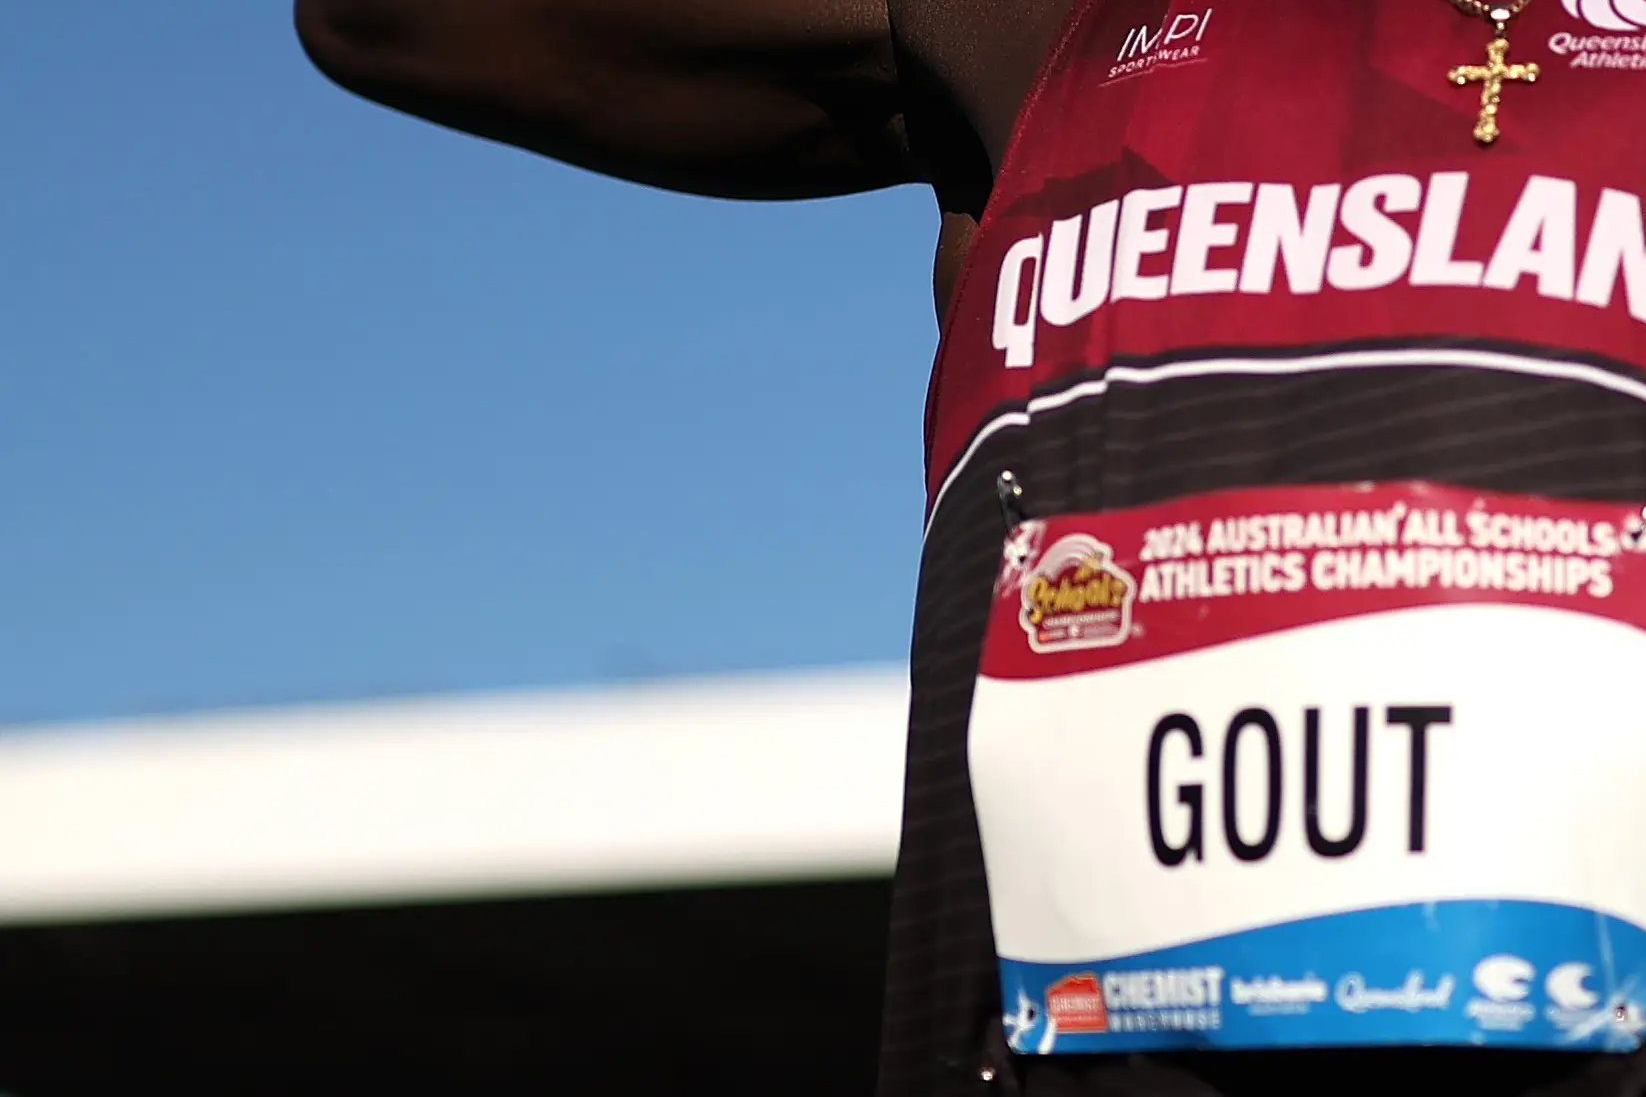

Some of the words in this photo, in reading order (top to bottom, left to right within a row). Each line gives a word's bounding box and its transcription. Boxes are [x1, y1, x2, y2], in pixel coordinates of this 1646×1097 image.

[1116, 7, 1213, 62] IMPI
[1205, 509, 1399, 555] AUSTRALIAN
[1400, 508, 1466, 546] ALL
[1464, 510, 1618, 557] SCHOOLS
[1139, 552, 1307, 603] ATHLETICS
[1310, 546, 1614, 599] CHAMPIONSHIPS
[1146, 704, 1452, 868] GOUT
[1103, 965, 1224, 1010] CHEMIST
